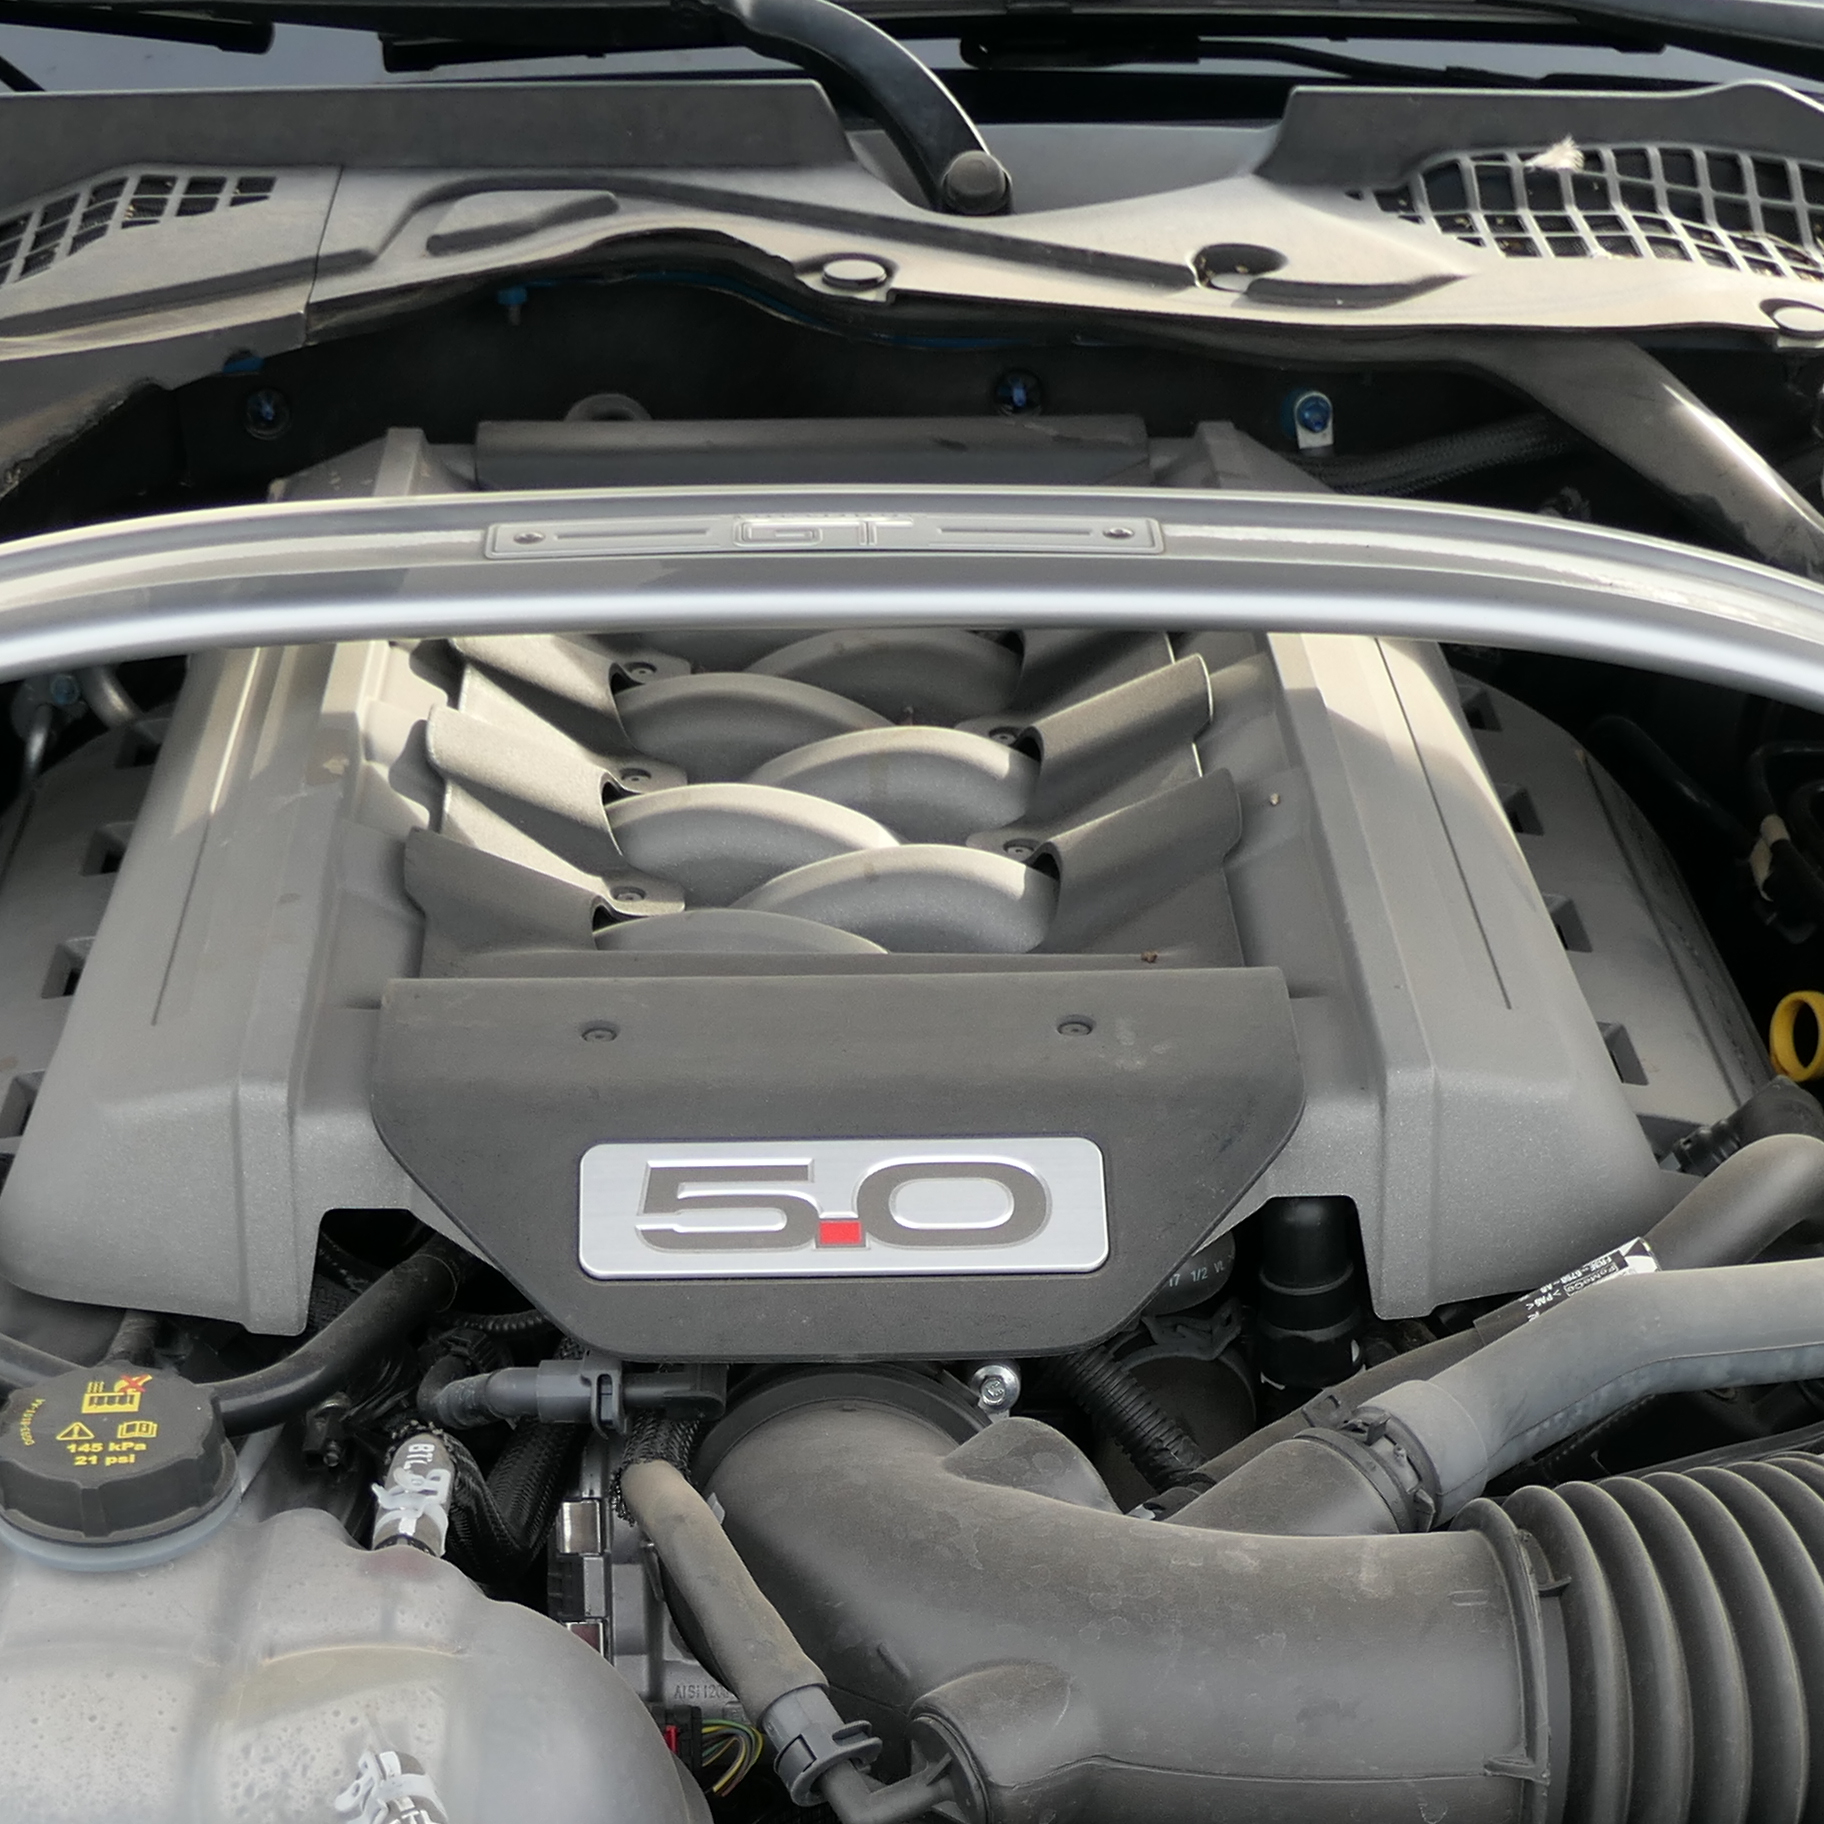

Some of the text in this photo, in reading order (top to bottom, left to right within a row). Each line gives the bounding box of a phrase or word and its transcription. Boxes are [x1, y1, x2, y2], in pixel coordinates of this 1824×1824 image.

[733, 518, 915, 548] GT
[635, 1155, 1053, 1254] 5.0
[1190, 1266, 1208, 1282] 1/2
[66, 1441, 147, 1453] 145 kPa
[74, 1454, 136, 1467] 21 psi
